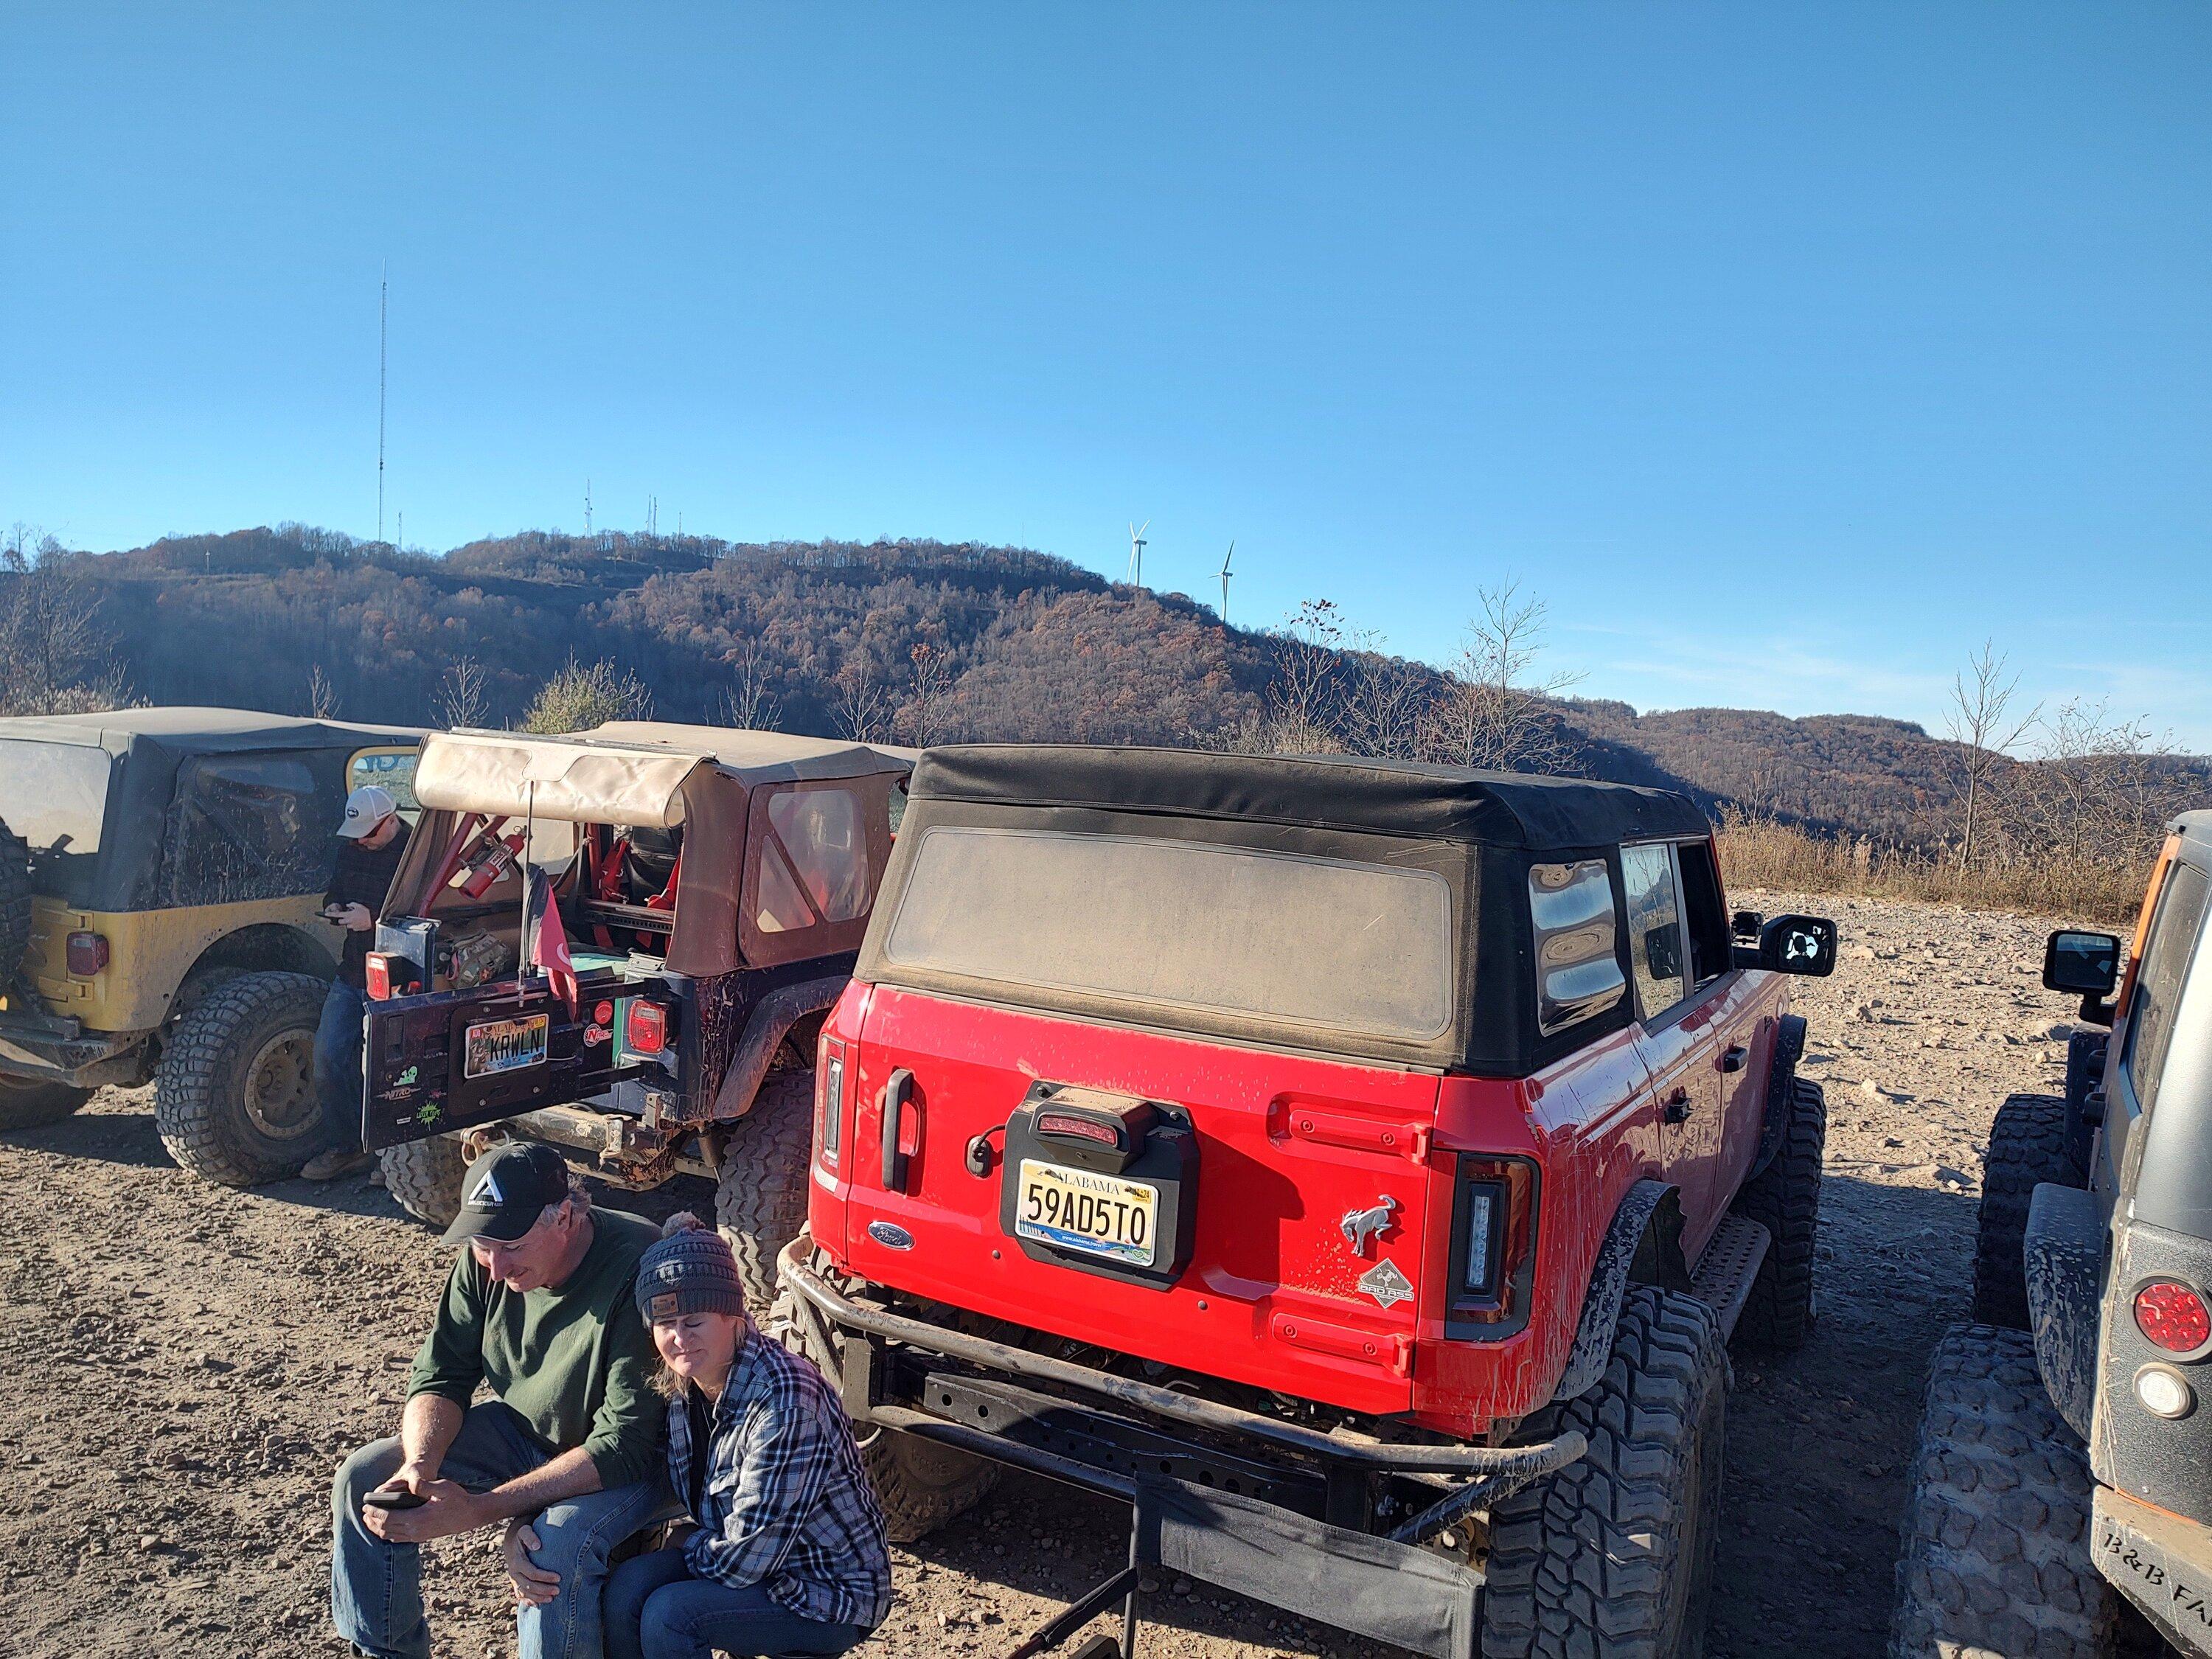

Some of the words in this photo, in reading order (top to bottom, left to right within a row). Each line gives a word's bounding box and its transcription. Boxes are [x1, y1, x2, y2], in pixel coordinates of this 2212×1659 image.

[490, 1029, 540, 1062] KRWLN
[385, 1087, 411, 1101] NITRO
[1055, 1171, 1120, 1195] ALABAMA
[877, 1226, 902, 1245] Ford
[1360, 1284, 1385, 1294] BAD
[1388, 1290, 1413, 1299] ASS
[2173, 1584, 2212, 1627] FA
